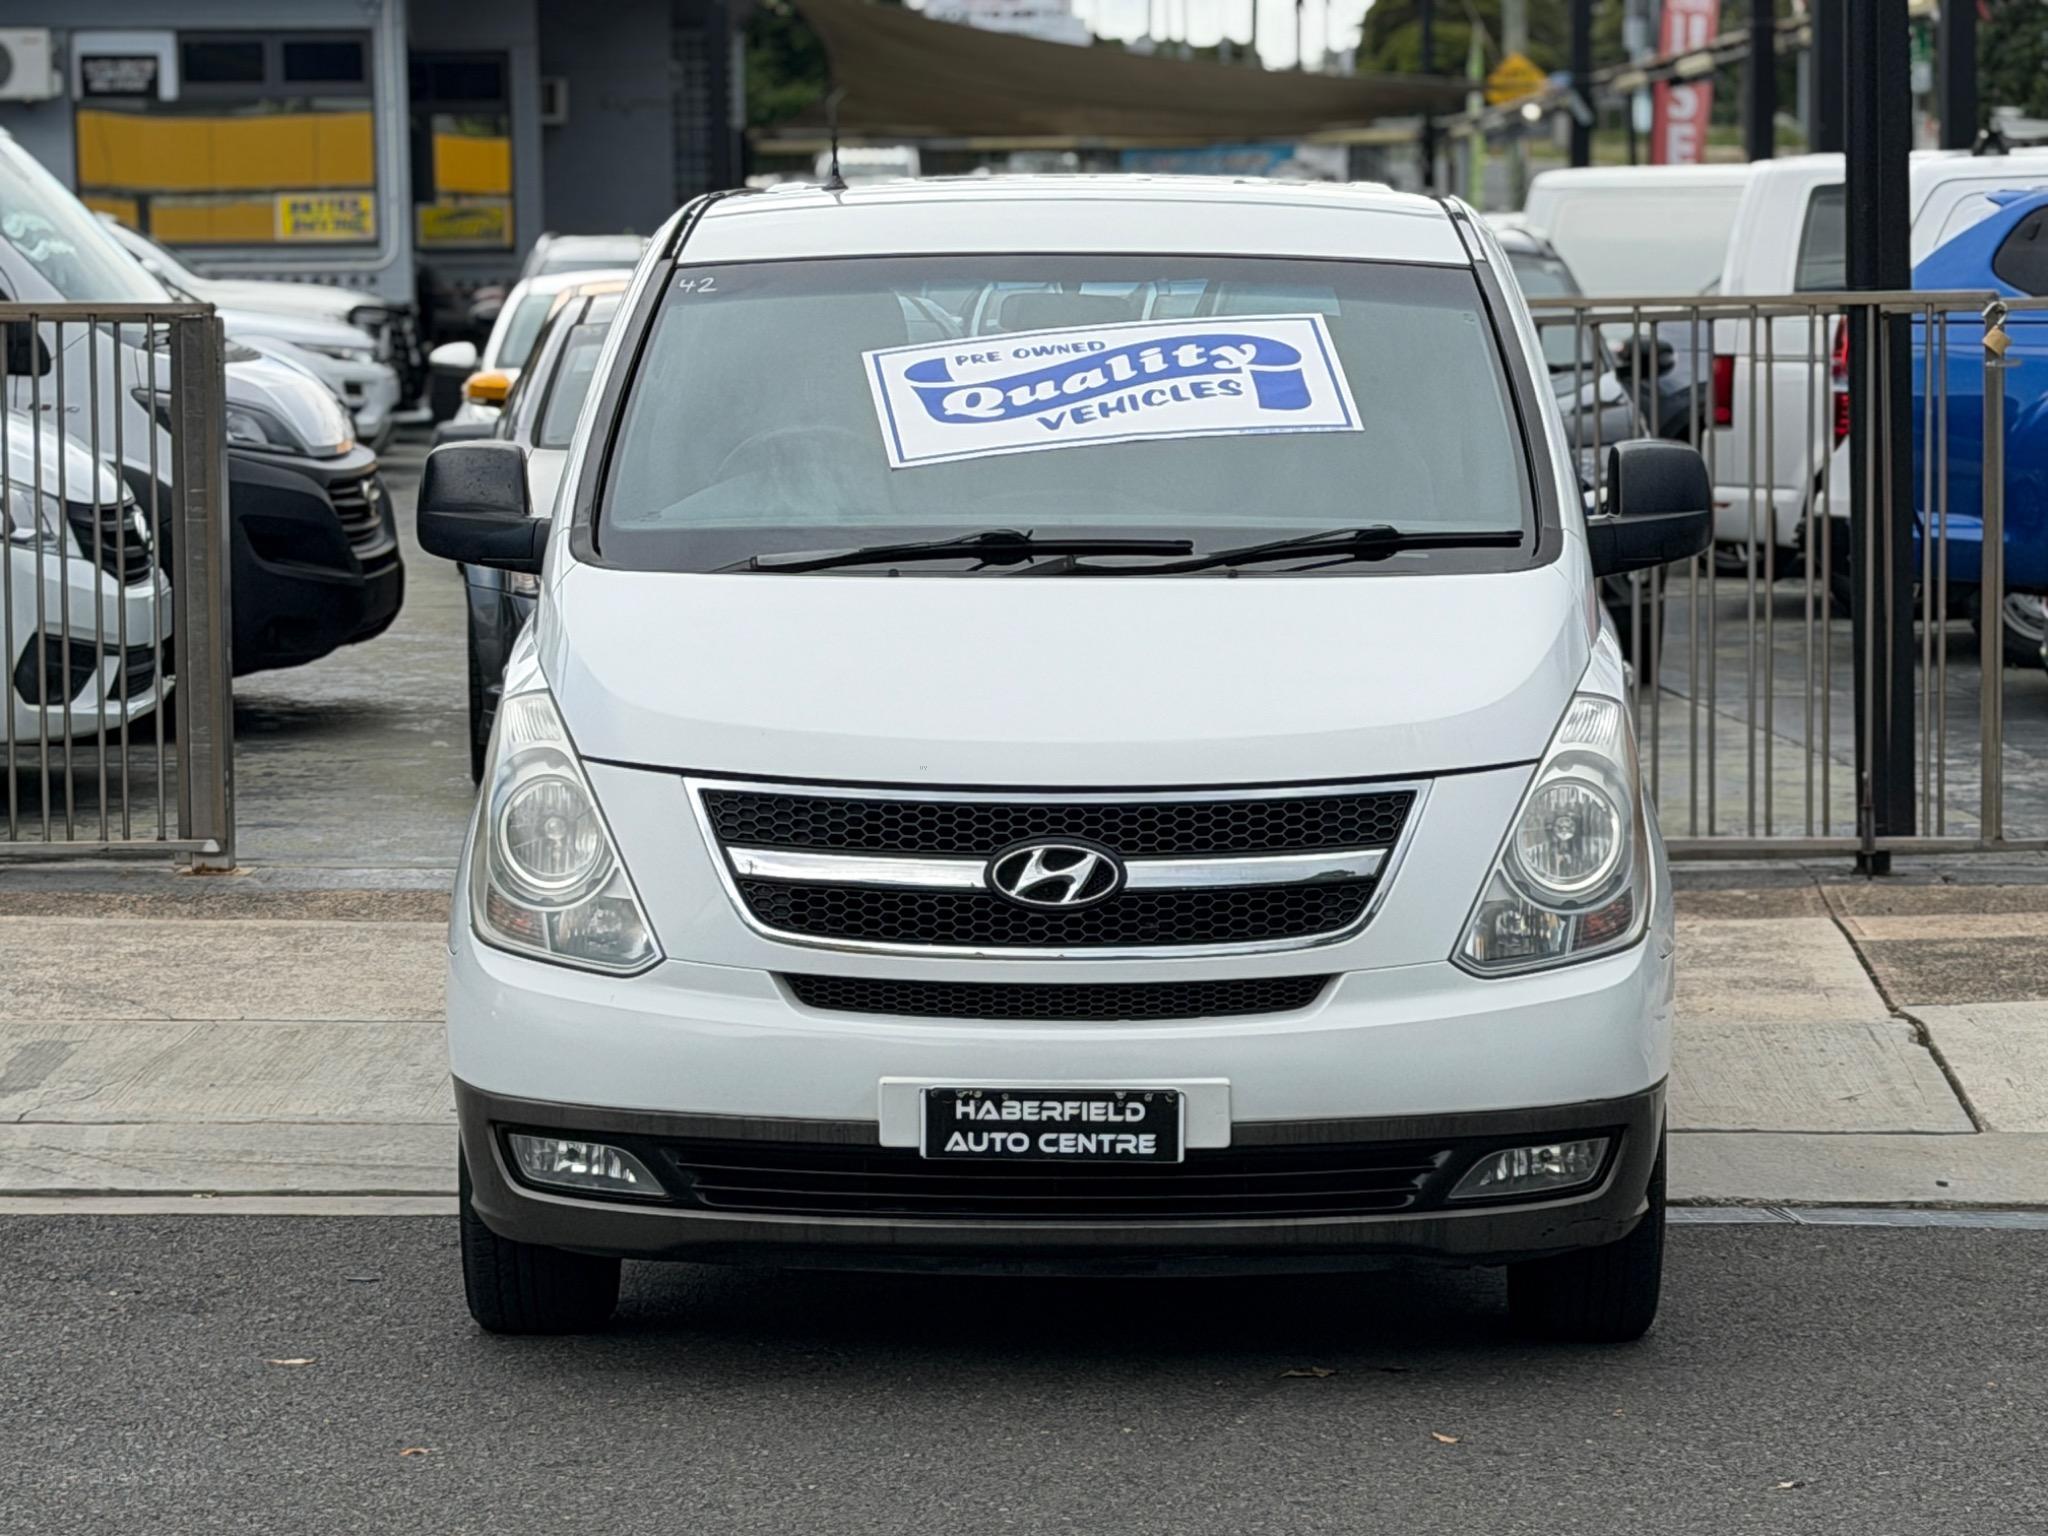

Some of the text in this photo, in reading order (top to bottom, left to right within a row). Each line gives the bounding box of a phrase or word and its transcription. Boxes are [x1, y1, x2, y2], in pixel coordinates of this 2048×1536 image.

[679, 277, 717, 293] 42
[955, 341, 1106, 366] PRE OWNED
[942, 343, 1257, 418] Quality
[1036, 379, 1243, 431] VEHICLES
[955, 1099, 1146, 1122] HABERFIELD
[944, 1131, 1156, 1154] AUTO CENTRE
